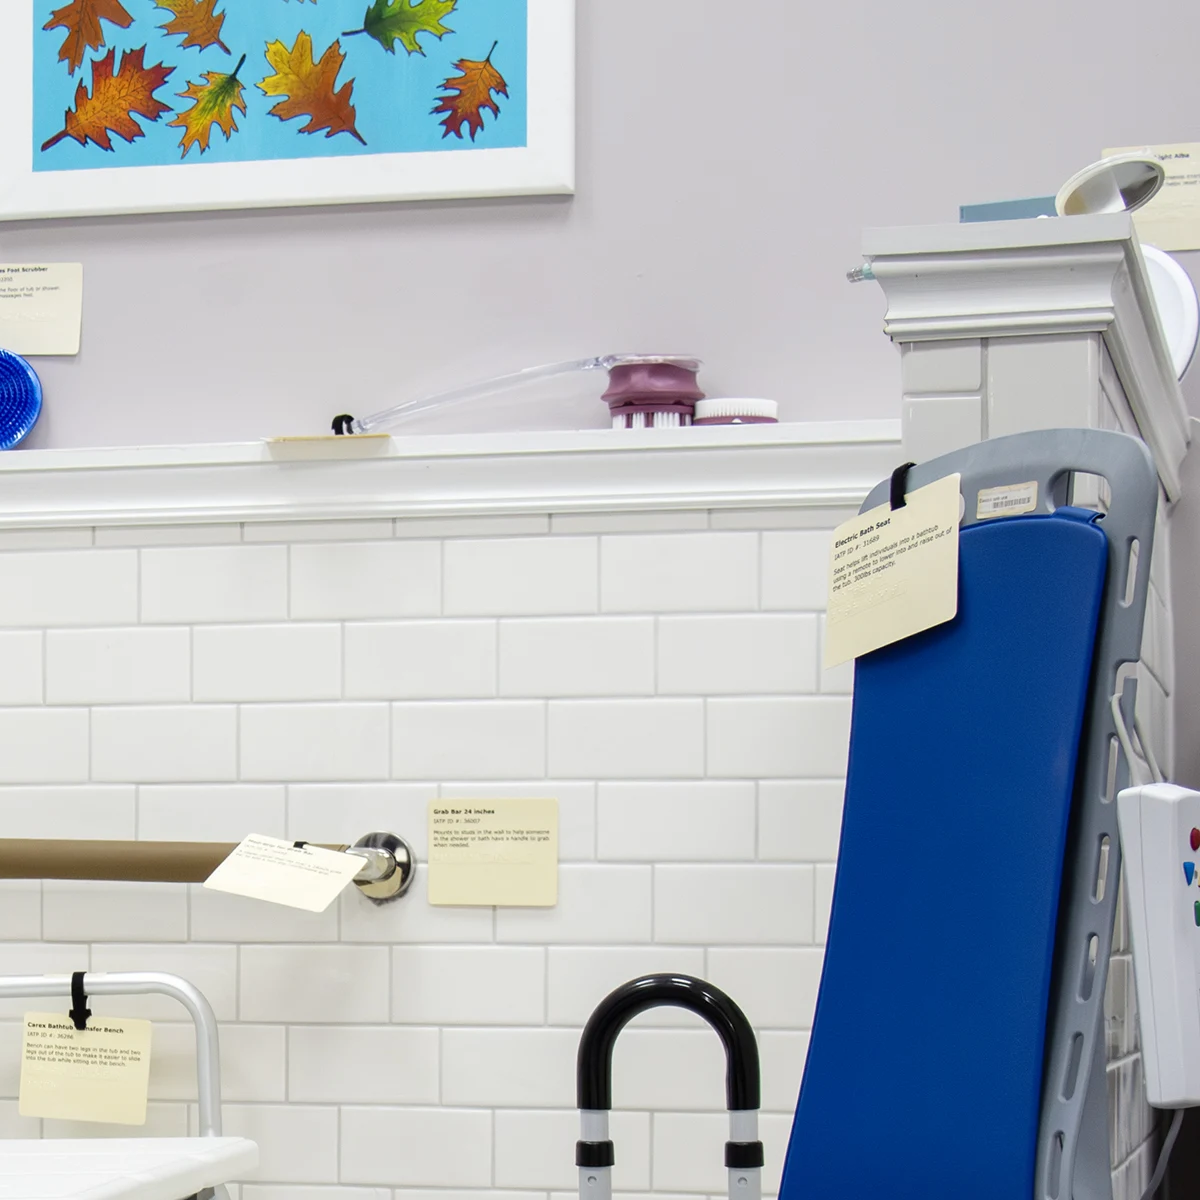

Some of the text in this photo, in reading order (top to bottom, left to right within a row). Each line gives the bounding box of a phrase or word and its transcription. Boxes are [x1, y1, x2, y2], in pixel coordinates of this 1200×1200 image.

[835, 518, 890, 548] Electric Bath Seat
[833, 573, 846, 582] using
[853, 562, 871, 574] remote
[880, 552, 894, 562] lower
[896, 547, 906, 556] into
[908, 541, 918, 550] and
[920, 536, 933, 545] raise
[935, 530, 944, 539] out
[834, 564, 845, 574] Seat
[847, 559, 860, 568] helps
[870, 543, 898, 559] individuals
[916, 524, 938, 539] bathtub
[834, 550, 846, 560] IATP
[847, 546, 853, 555] ID
[842, 579, 852, 587] tub.
[854, 571, 871, 582] 300lbs
[873, 561, 896, 574] capacity.
